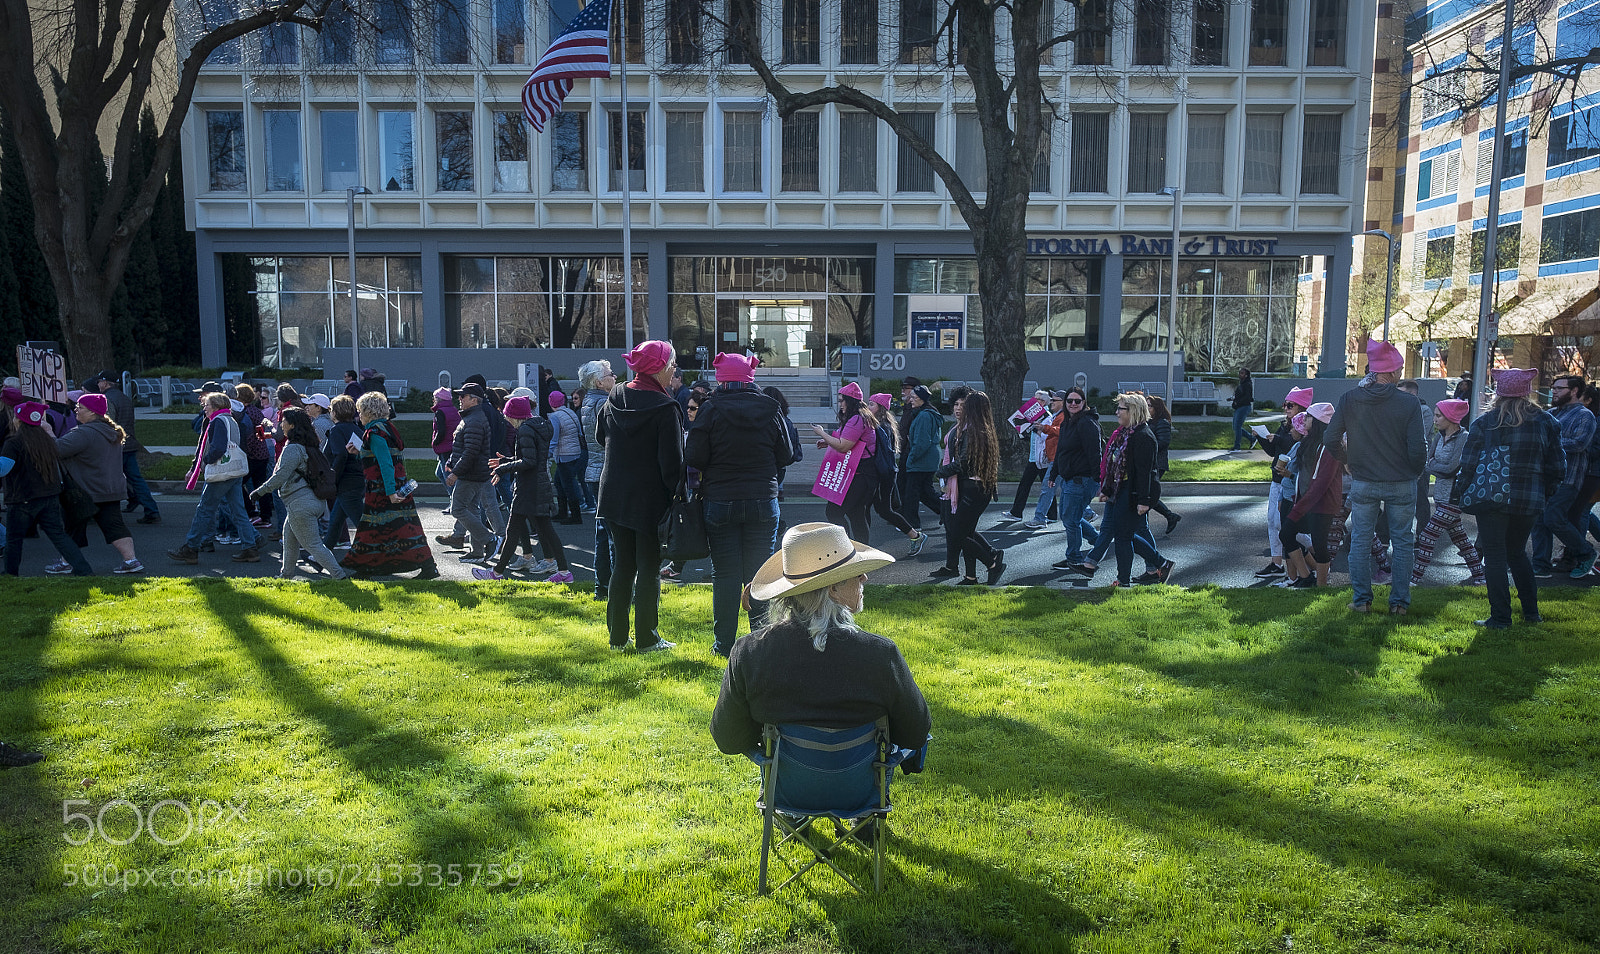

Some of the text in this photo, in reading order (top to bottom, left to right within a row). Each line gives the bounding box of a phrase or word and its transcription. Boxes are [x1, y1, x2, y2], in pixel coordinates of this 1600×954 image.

[1027, 238, 1113, 254] IFORNIA
[1184, 237, 1204, 255] &
[1206, 235, 1278, 255] TRUST
[755, 266, 788, 287] 520
[19, 346, 62, 379] THE MCP
[869, 353, 906, 371] 520
[21, 372, 64, 402] IS NMP
[821, 462, 830, 482] STAND
[824, 471, 833, 487] WITH
[829, 462, 841, 489] PLANNED
[834, 450, 851, 491] PARENTHOOD
